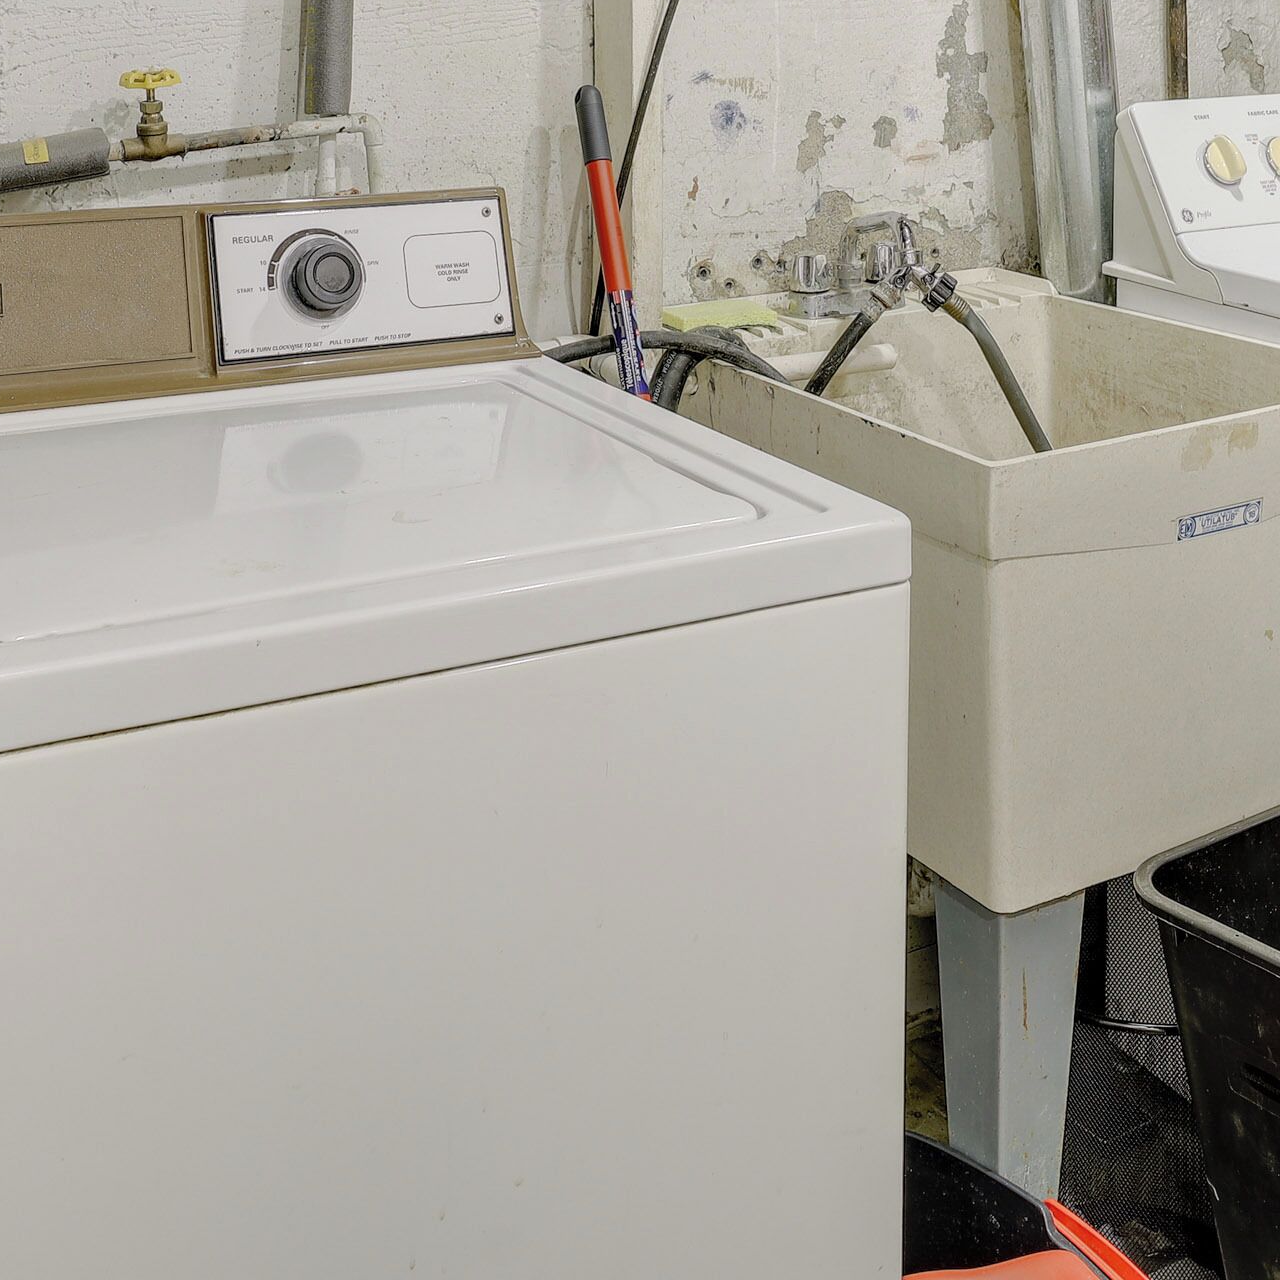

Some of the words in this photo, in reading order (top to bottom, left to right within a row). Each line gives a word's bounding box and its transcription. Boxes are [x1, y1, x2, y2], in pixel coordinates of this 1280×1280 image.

[1194, 113, 1210, 121] START
[232, 234, 274, 245] REGULAR
[453, 261, 470, 269] WASH
[437, 269, 452, 277] COLD
[236, 287, 254, 295] START
[351, 336, 369, 344] START
[374, 334, 389, 342] PUSH
[234, 347, 250, 355] PUSH
[256, 345, 272, 353] TURN
[272, 343, 303, 352] CLOCKWISE
